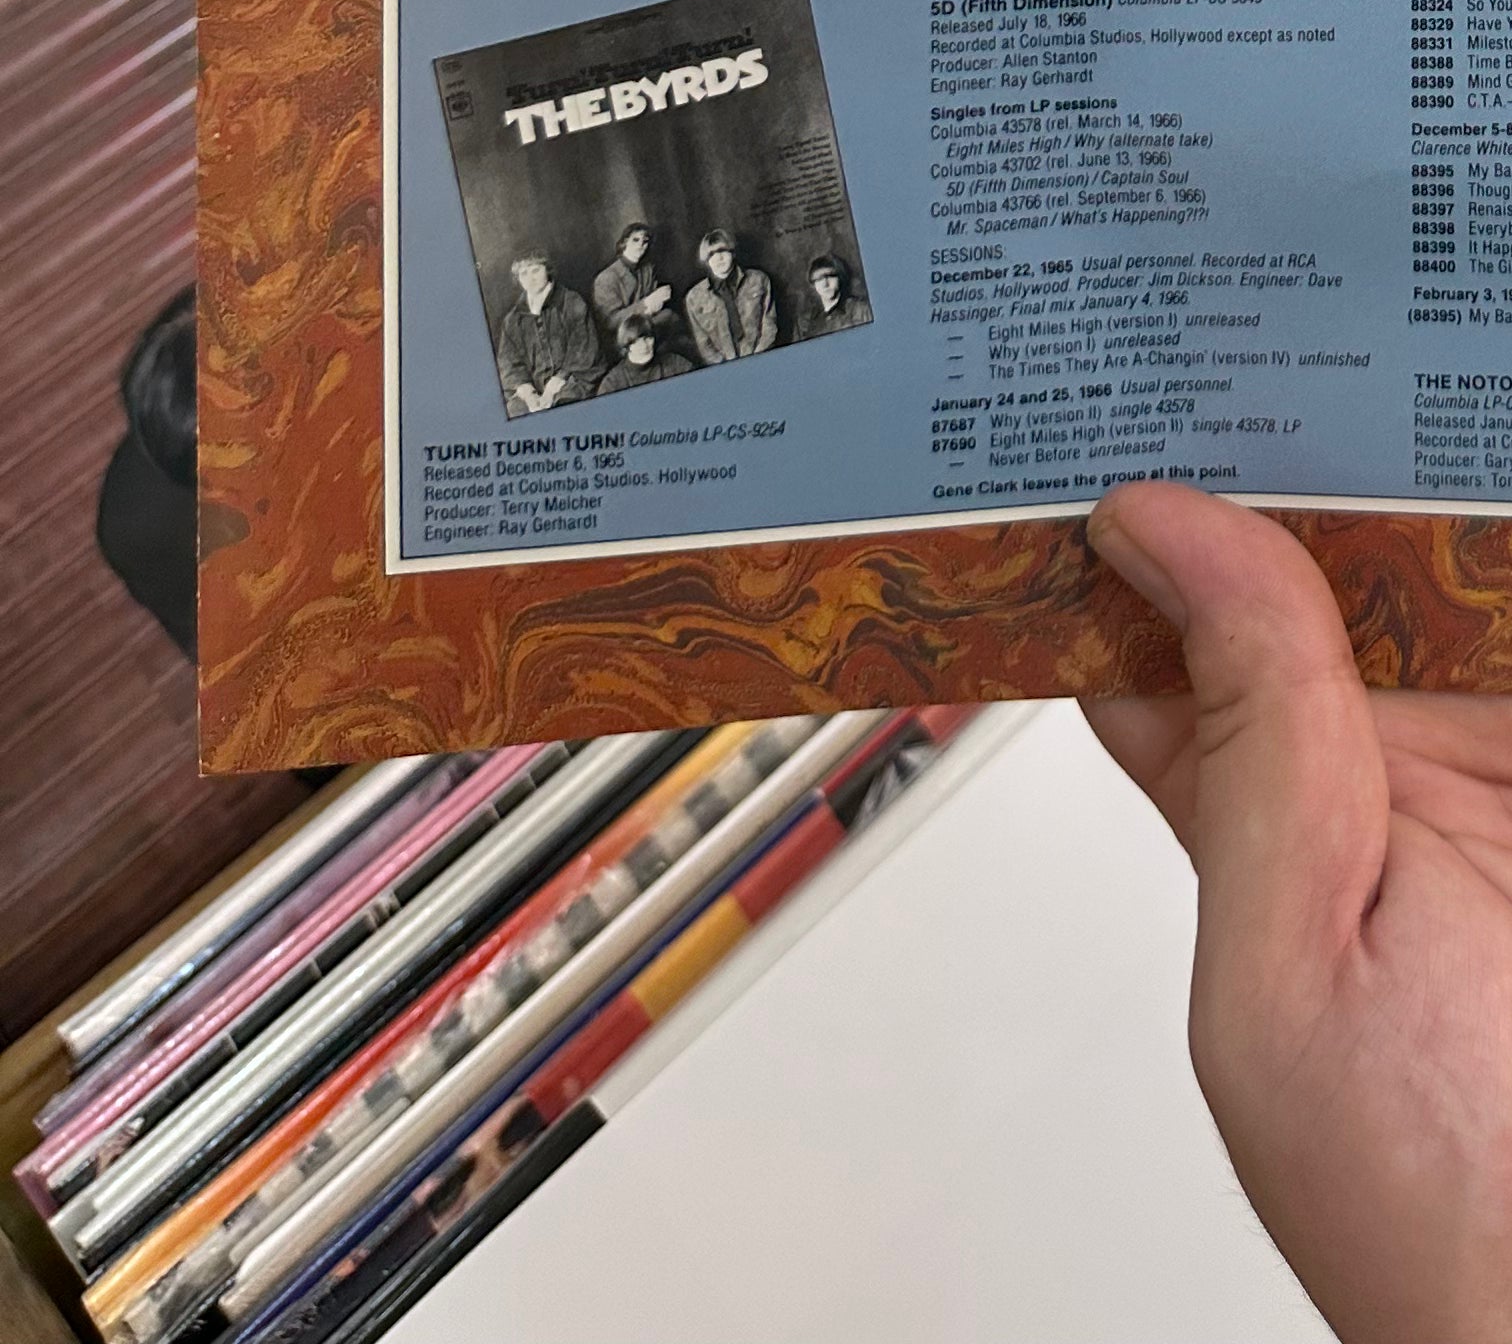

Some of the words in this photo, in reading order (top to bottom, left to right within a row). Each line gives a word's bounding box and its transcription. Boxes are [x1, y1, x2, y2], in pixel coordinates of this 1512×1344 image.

[930, 0, 955, 16] 5D
[1410, 36, 1452, 50] 88331
[1413, 373, 1451, 389] THE
[1413, 392, 1478, 410] Columbia
[423, 441, 487, 462] TURN!
[492, 437, 555, 457] TURN!
[561, 432, 624, 452] TURN!
[629, 428, 698, 447] Columbia
[702, 420, 785, 441] LP-CS-9254
[932, 484, 973, 498] Gene
[976, 479, 1017, 494] Clark
[1022, 477, 1068, 491] leaves
[1073, 473, 1097, 486] the
[1149, 466, 1164, 480] at
[1168, 465, 1194, 478] this
[1199, 464, 1239, 480] point.
